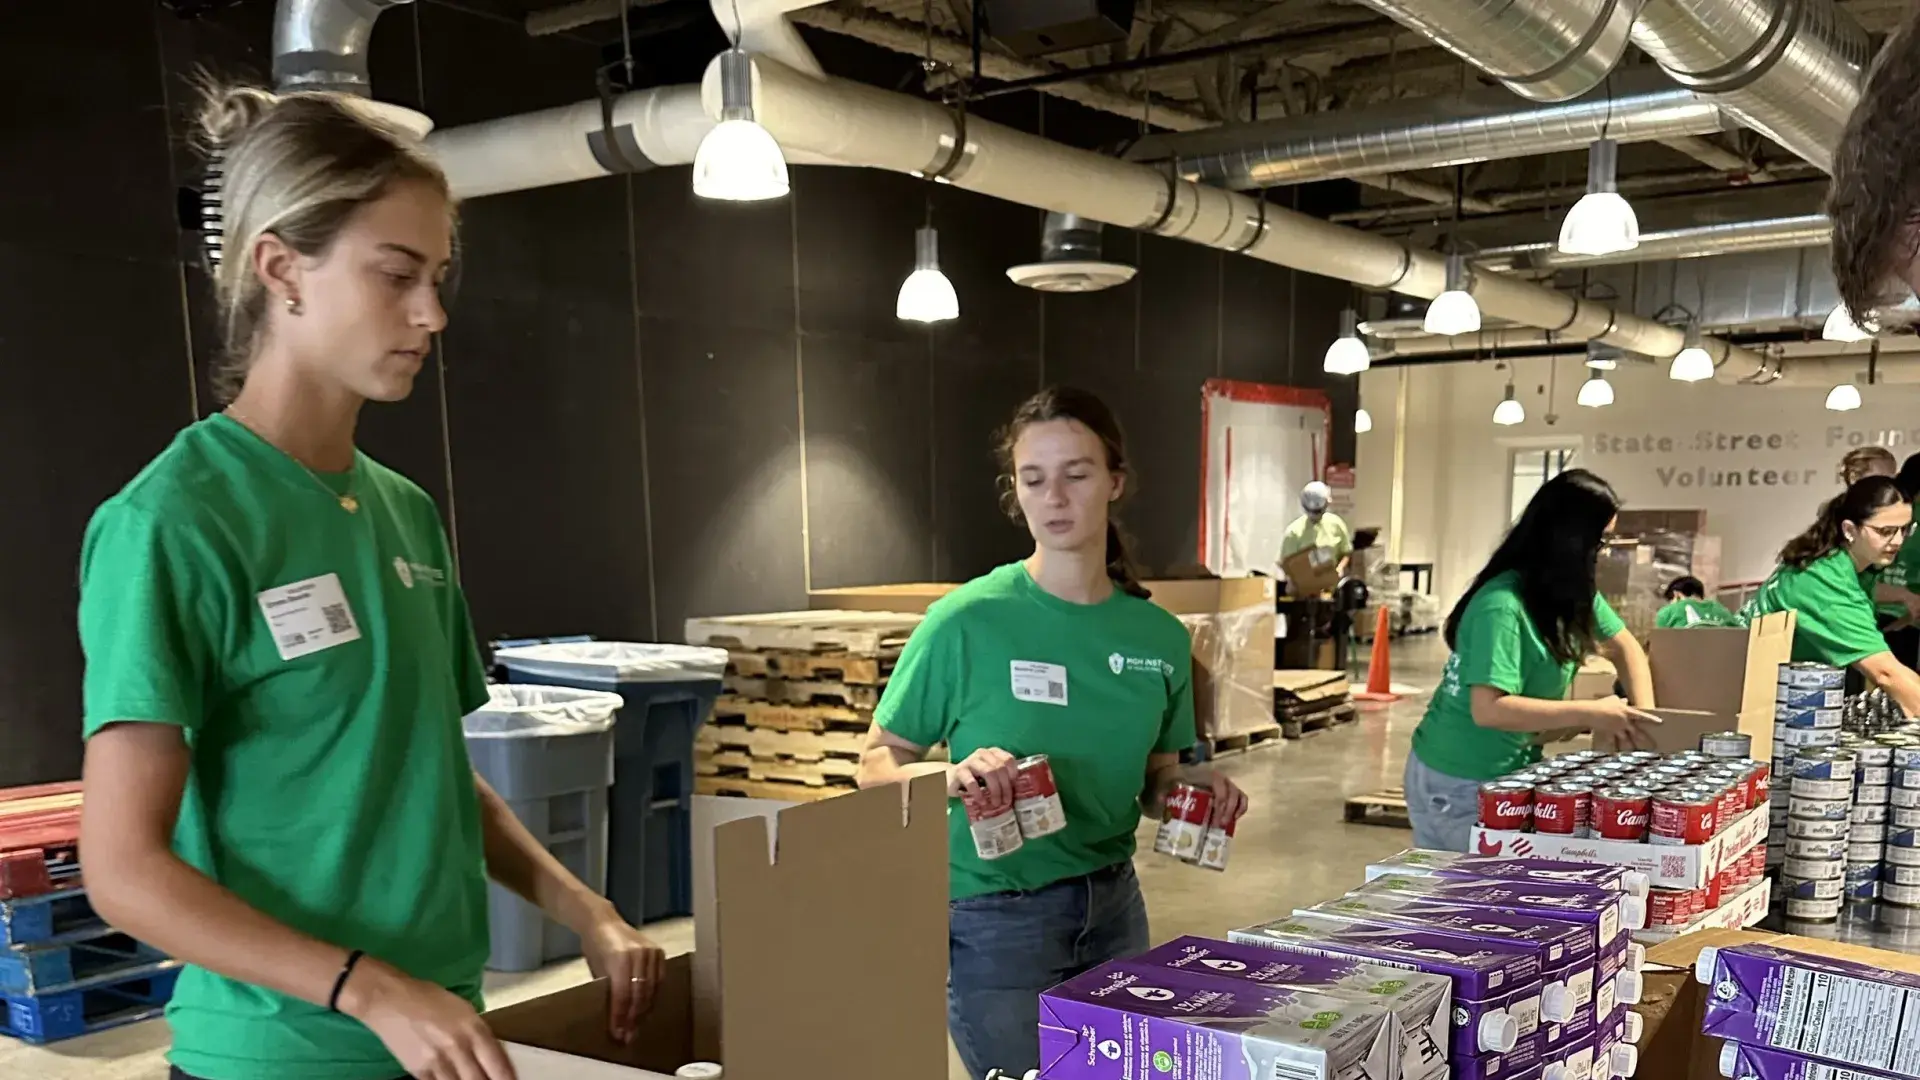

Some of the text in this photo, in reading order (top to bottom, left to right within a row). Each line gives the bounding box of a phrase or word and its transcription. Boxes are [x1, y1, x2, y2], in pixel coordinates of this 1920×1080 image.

[1594, 432, 1672, 454] State
[1656, 465, 1818, 488] Volunteer
[1561, 846, 1598, 859] Campbell's
[1090, 974, 1139, 997] Schreiber
[1816, 972, 1828, 988] 110
[1088, 1026, 1096, 1066] Schreiber
